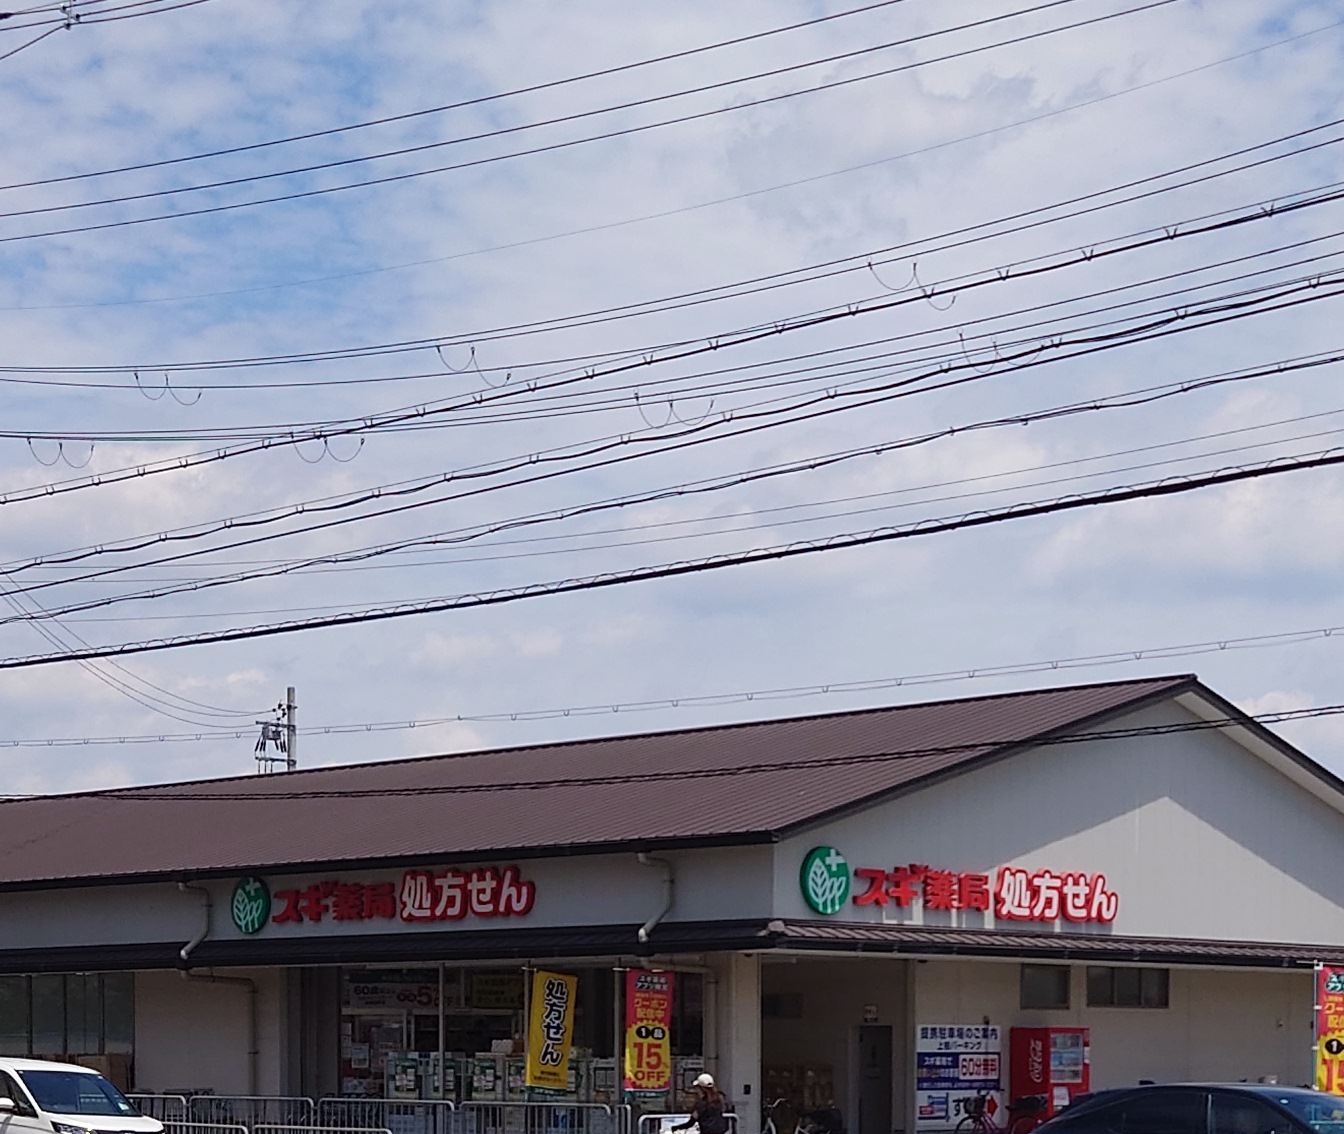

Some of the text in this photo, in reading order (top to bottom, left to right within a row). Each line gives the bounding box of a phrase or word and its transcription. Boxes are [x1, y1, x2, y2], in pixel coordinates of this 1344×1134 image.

[272, 866, 535, 923] スギ薬局 処方せん
[853, 864, 1118, 922] スギ薬局 処方せん
[540, 977, 567, 1066] 処方せん
[634, 1070, 666, 1081] OFF
